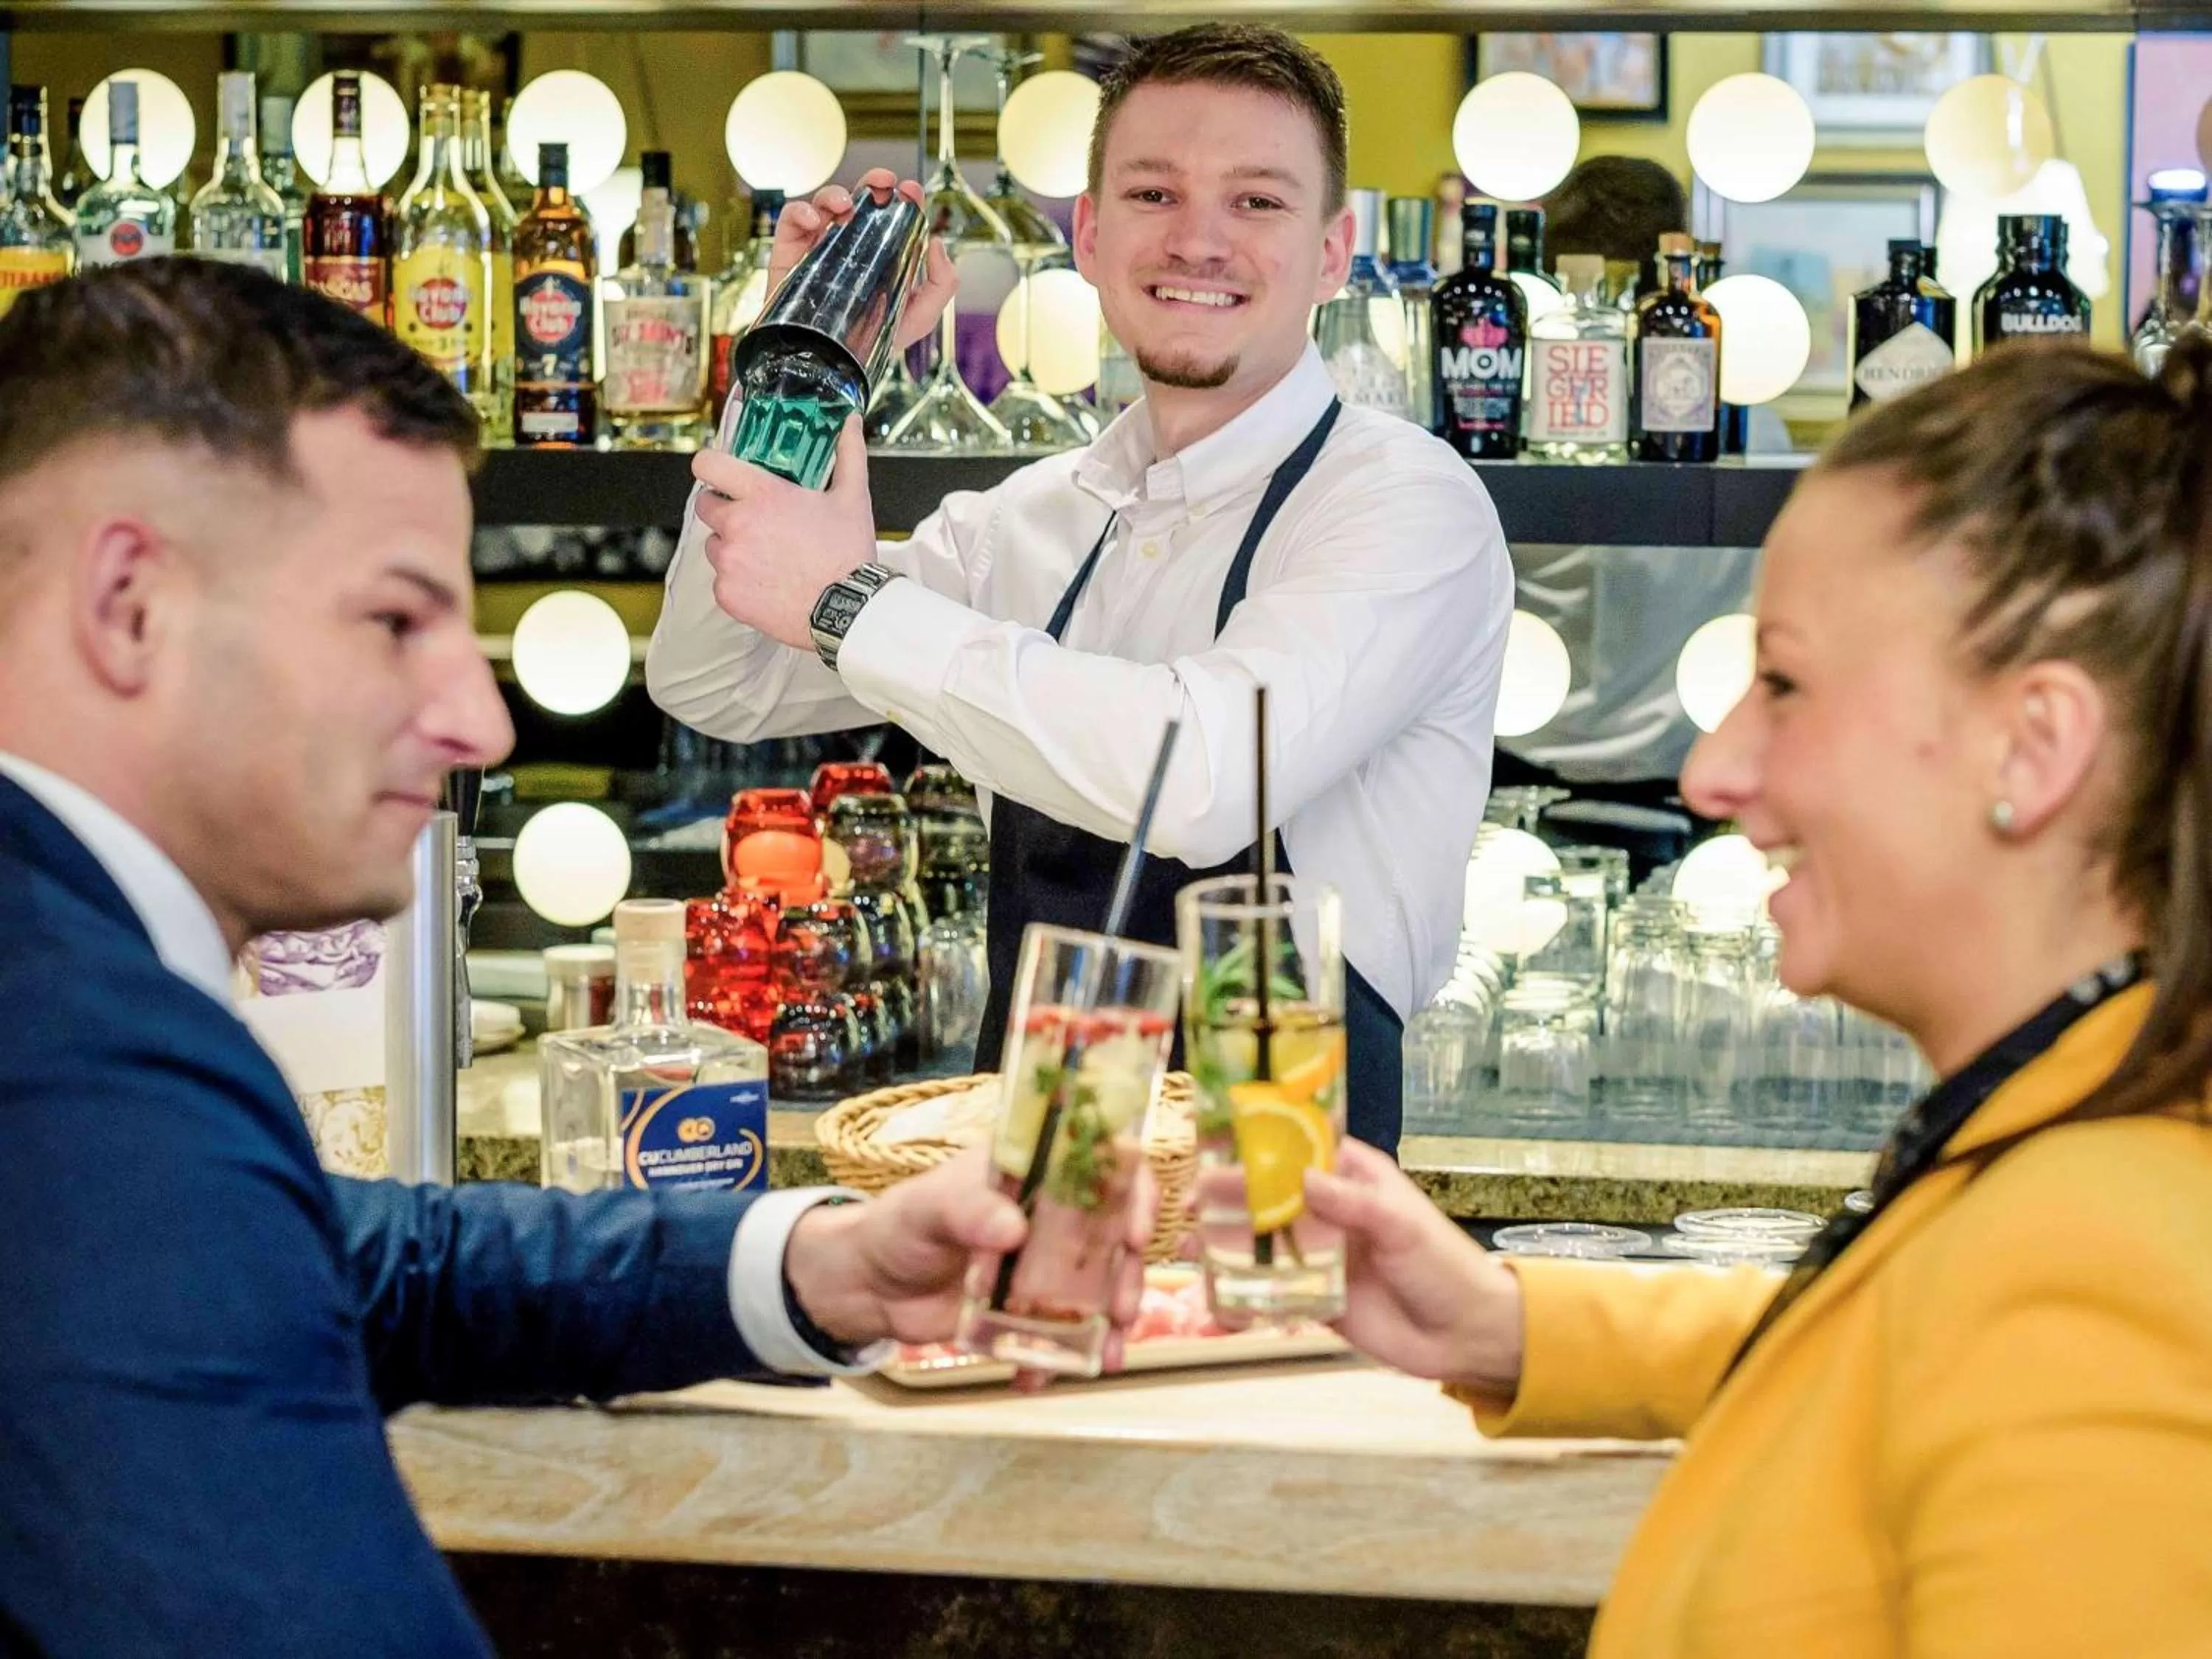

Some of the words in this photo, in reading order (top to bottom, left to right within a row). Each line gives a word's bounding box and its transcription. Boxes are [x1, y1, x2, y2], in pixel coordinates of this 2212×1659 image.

[541, 353, 557, 376] 7
[1441, 346, 1522, 380] MOM
[1548, 344, 1609, 373] SIE
[639, 1141, 753, 1166] CUCUMBERLAND
